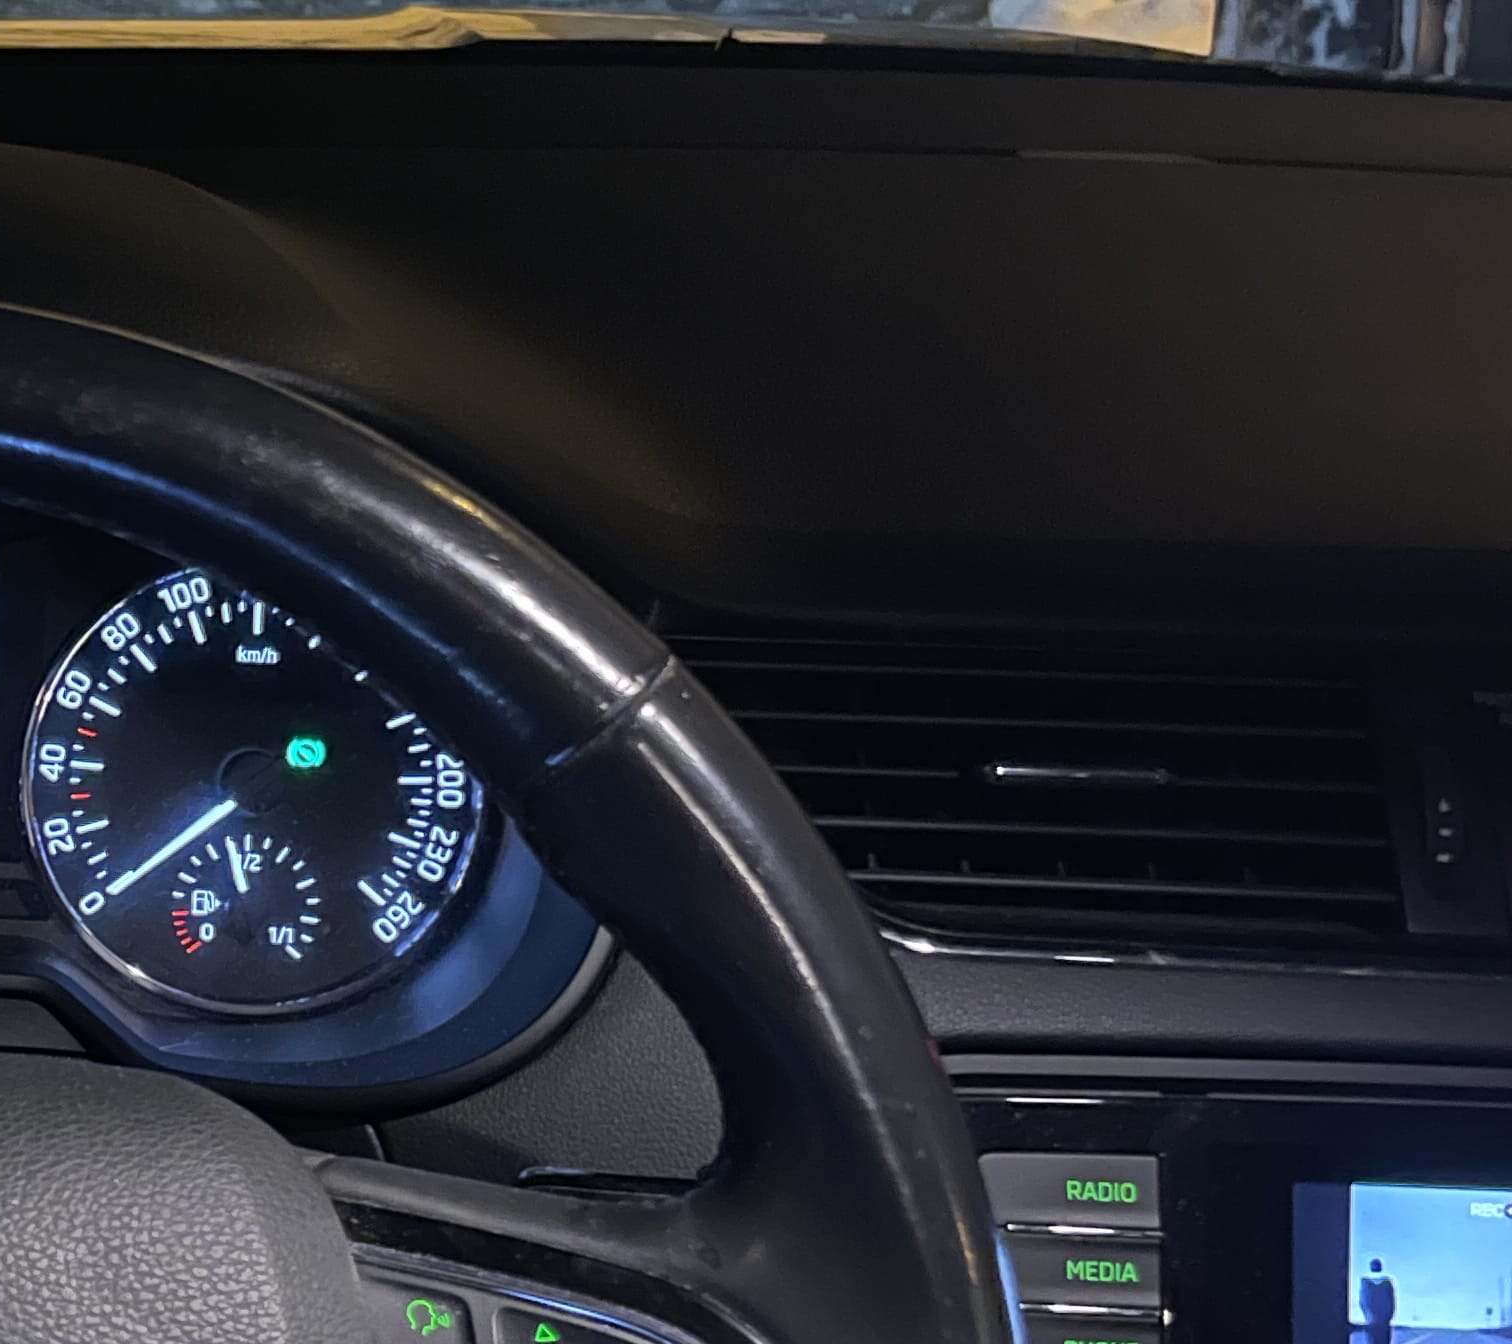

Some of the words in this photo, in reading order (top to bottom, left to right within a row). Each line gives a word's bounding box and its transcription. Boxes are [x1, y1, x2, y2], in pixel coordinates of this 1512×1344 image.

[157, 577, 210, 613] 100
[100, 613, 141, 649] 80
[235, 646, 280, 664] km/h
[55, 670, 91, 709] 60
[39, 743, 67, 782] 40
[435, 753, 466, 808] 200
[44, 818, 76, 855] 20
[416, 827, 458, 883] 230
[79, 890, 105, 915] 0
[373, 894, 424, 943] 260
[199, 923, 215, 942] 0
[268, 926, 296, 945] 1/1
[1065, 1179, 1138, 1203] RADIO
[1065, 1259, 1140, 1284] MEDIA
